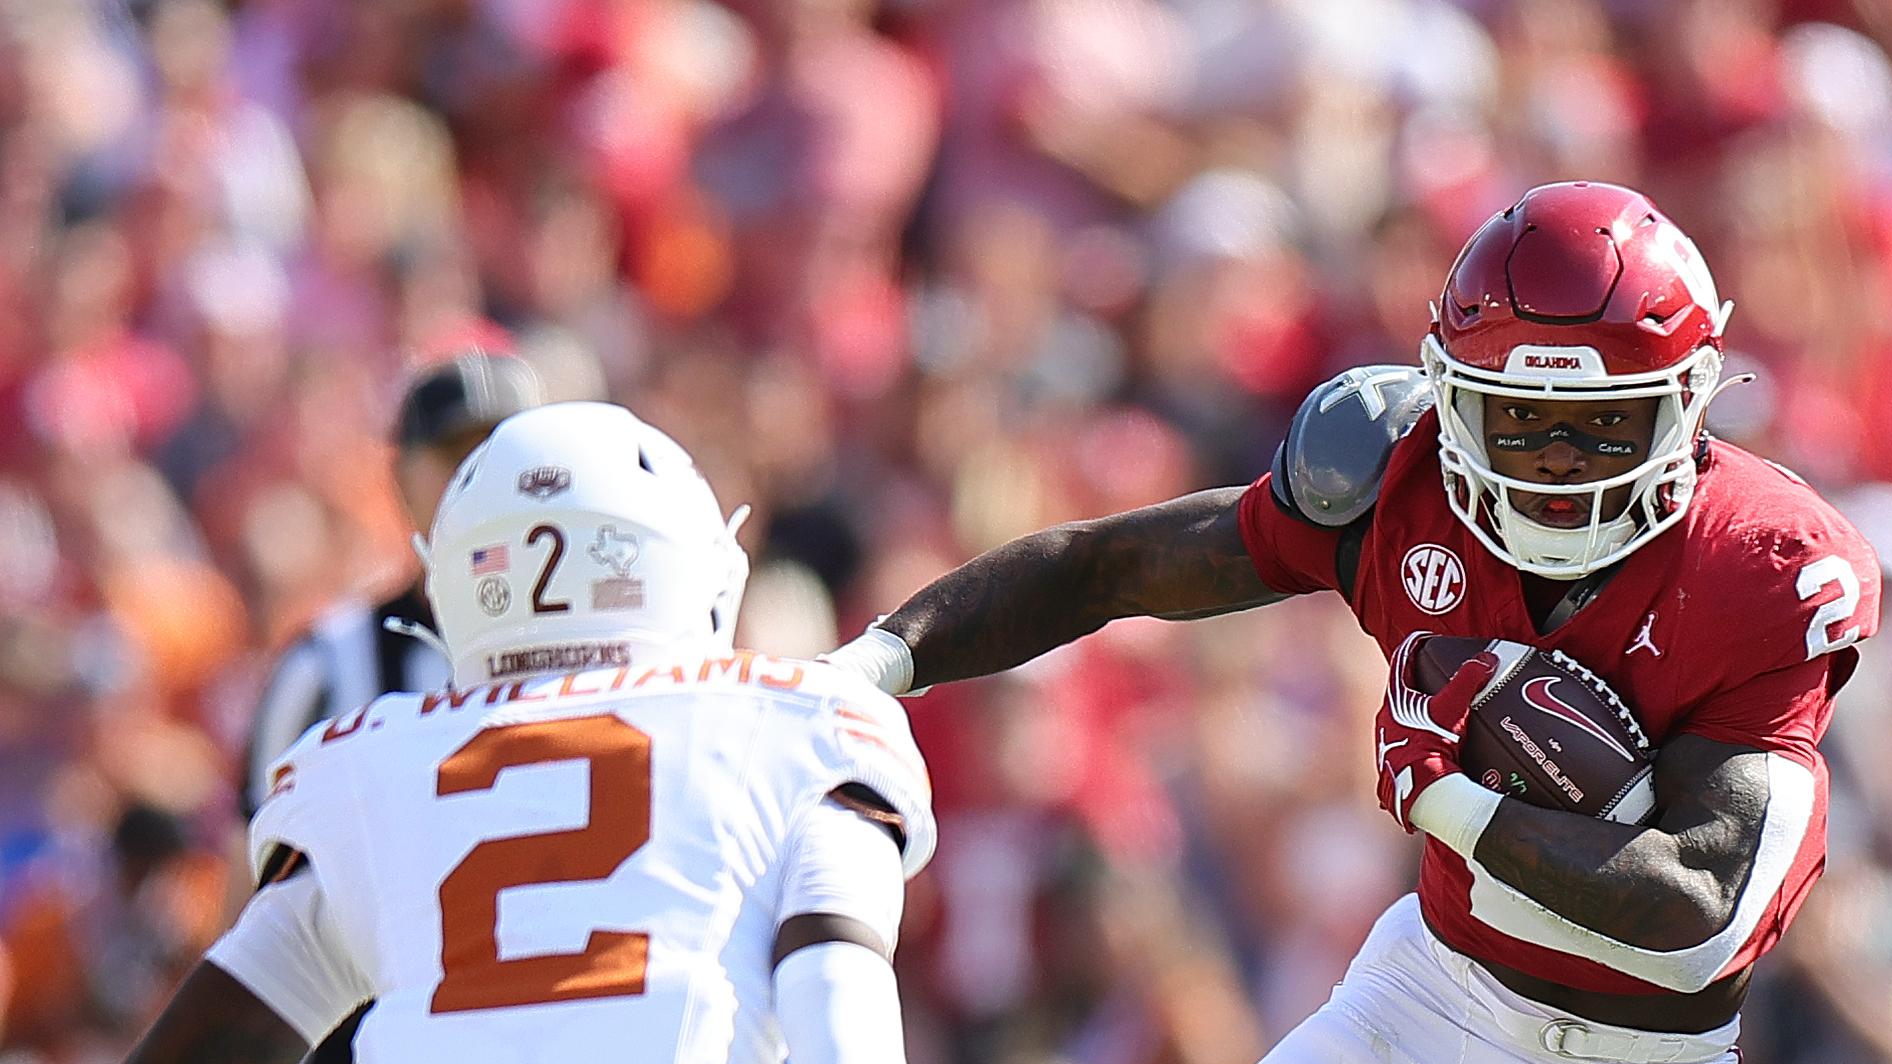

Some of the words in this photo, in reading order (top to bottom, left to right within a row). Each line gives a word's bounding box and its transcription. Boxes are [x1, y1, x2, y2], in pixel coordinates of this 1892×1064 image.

[1525, 355, 1582, 370] OKLAHOMA
[526, 524, 570, 614] 2
[1406, 550, 1461, 610] SEC
[1796, 554, 1860, 662] 2
[1500, 715, 1546, 767] VAPOR
[1542, 760, 1585, 804] ELITE
[429, 712, 652, 1015] 2
